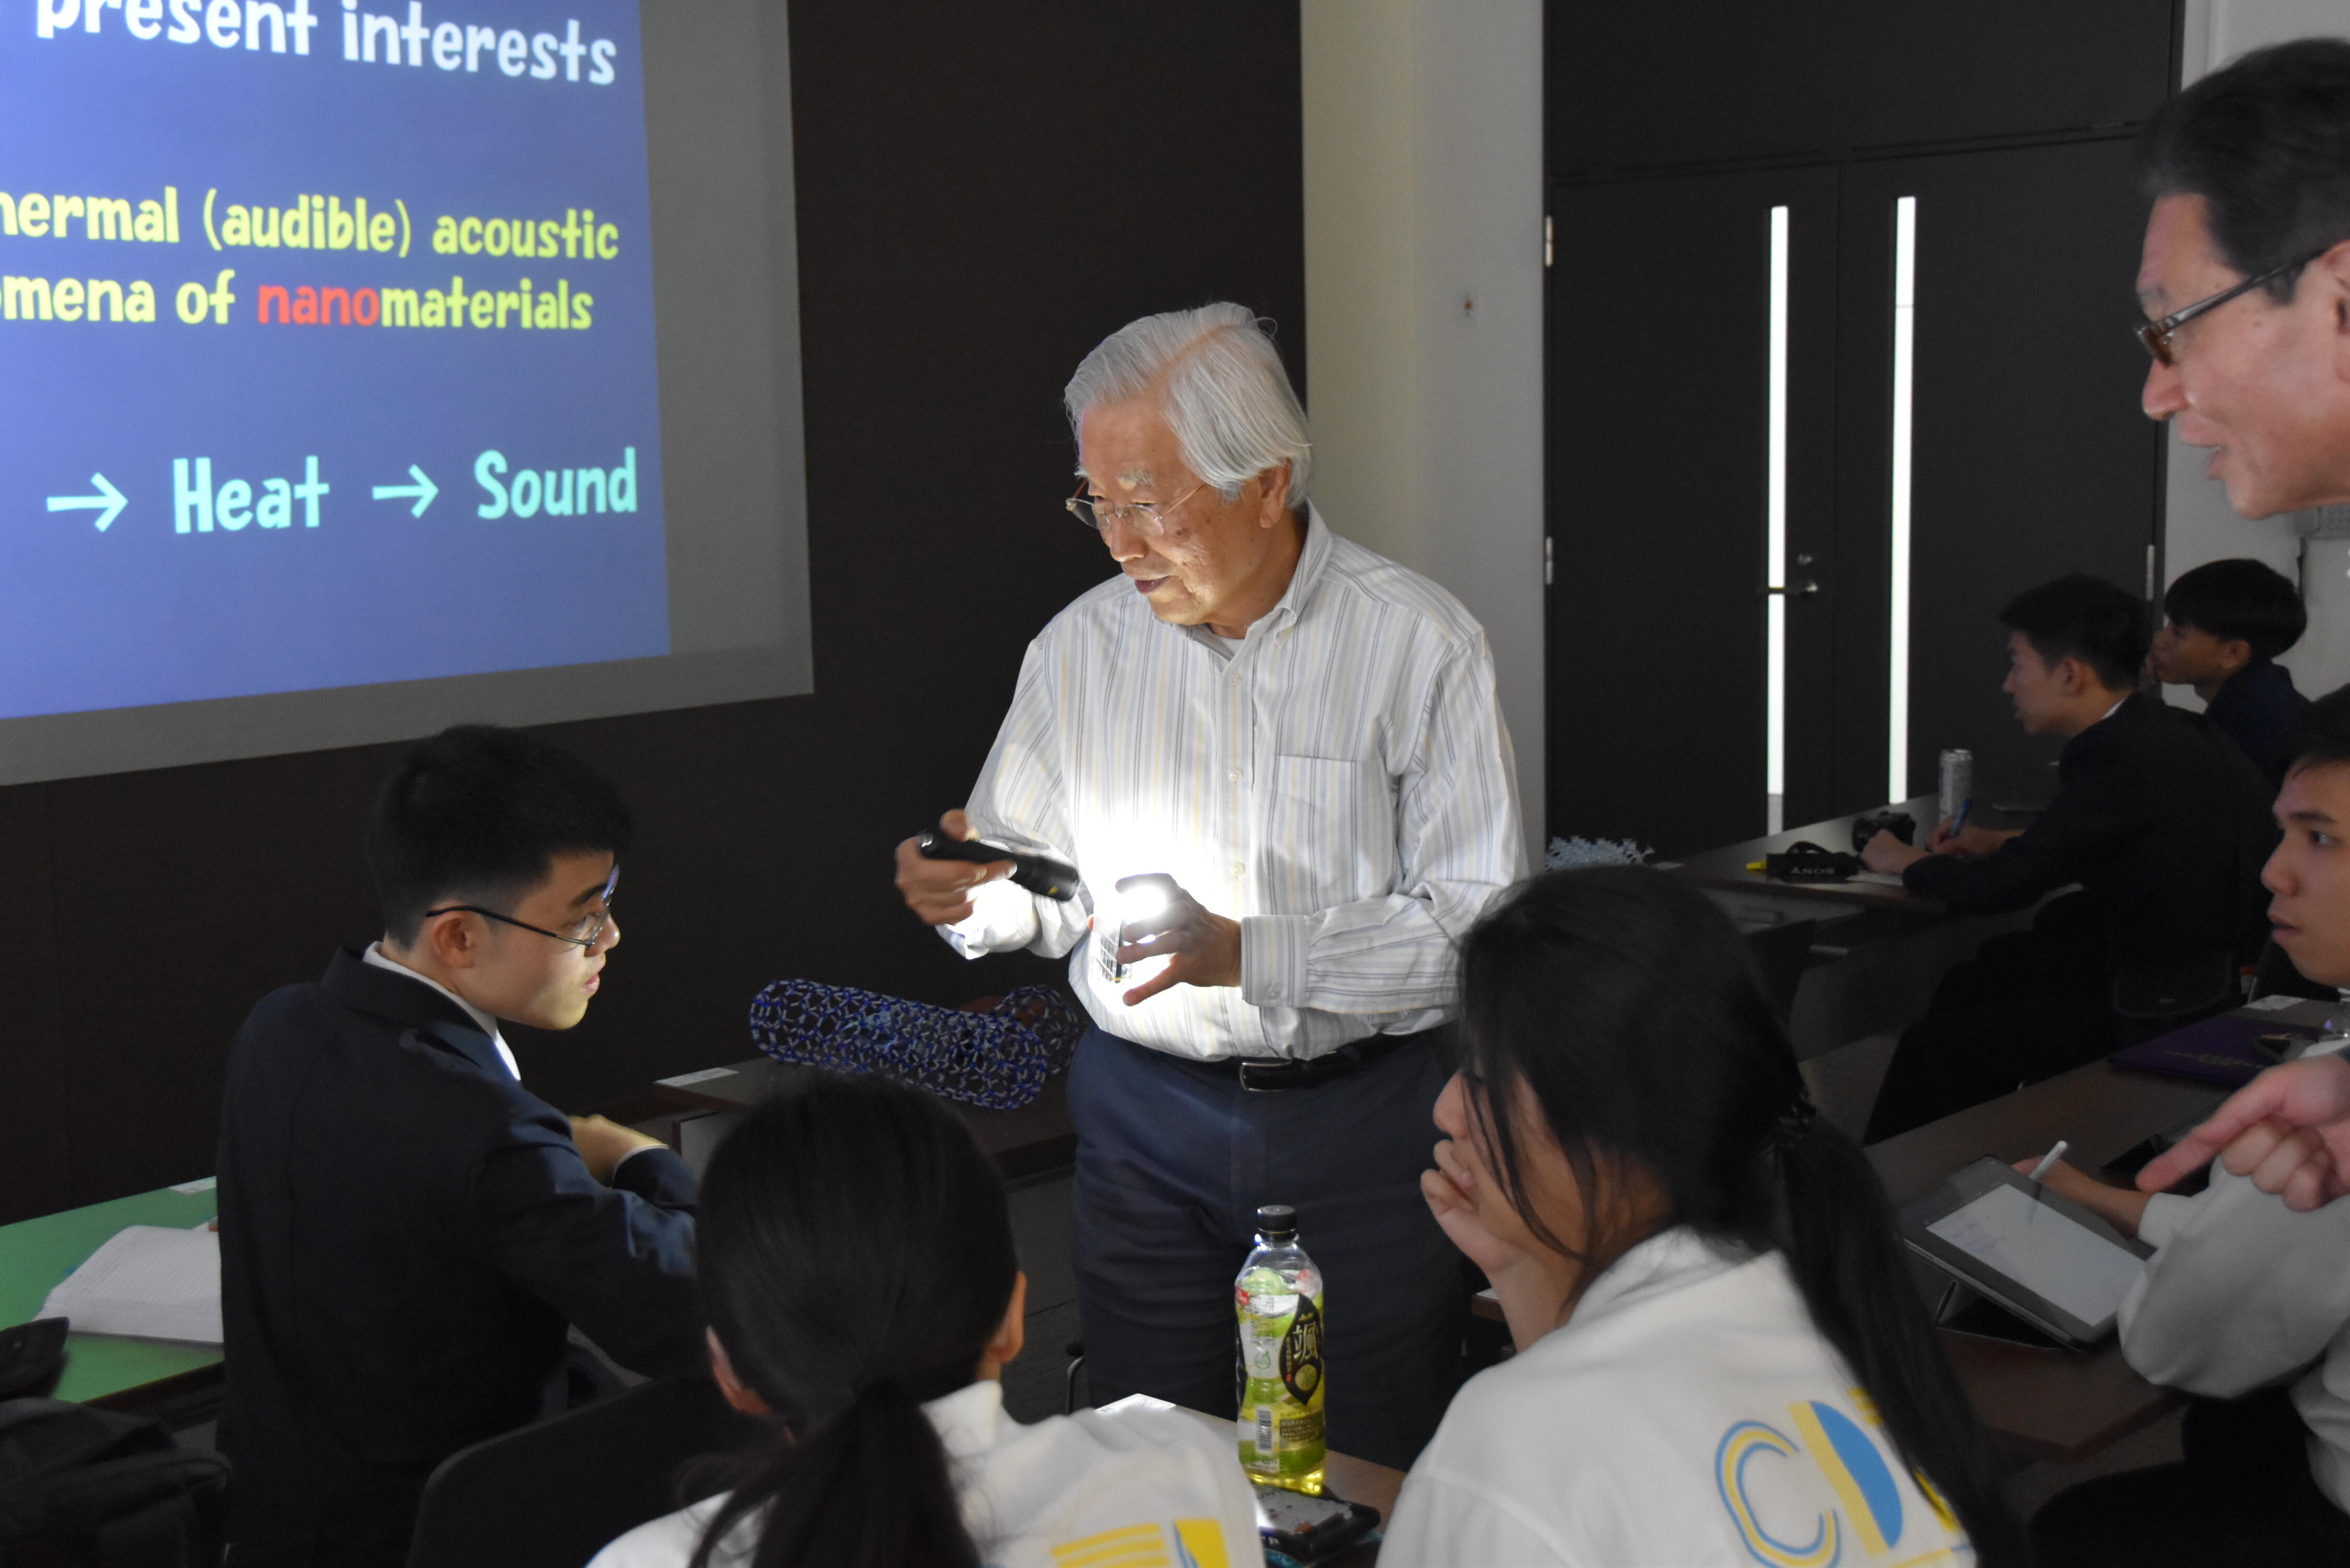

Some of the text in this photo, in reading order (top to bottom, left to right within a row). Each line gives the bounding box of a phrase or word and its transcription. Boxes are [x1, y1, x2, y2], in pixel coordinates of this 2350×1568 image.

[36, 0, 617, 85] present interests
[203, 188, 411, 258] (audible)
[432, 209, 619, 259] acoustic
[0, 269, 593, 329] mena of nanomaterials
[173, 446, 638, 534] Heat Sound
